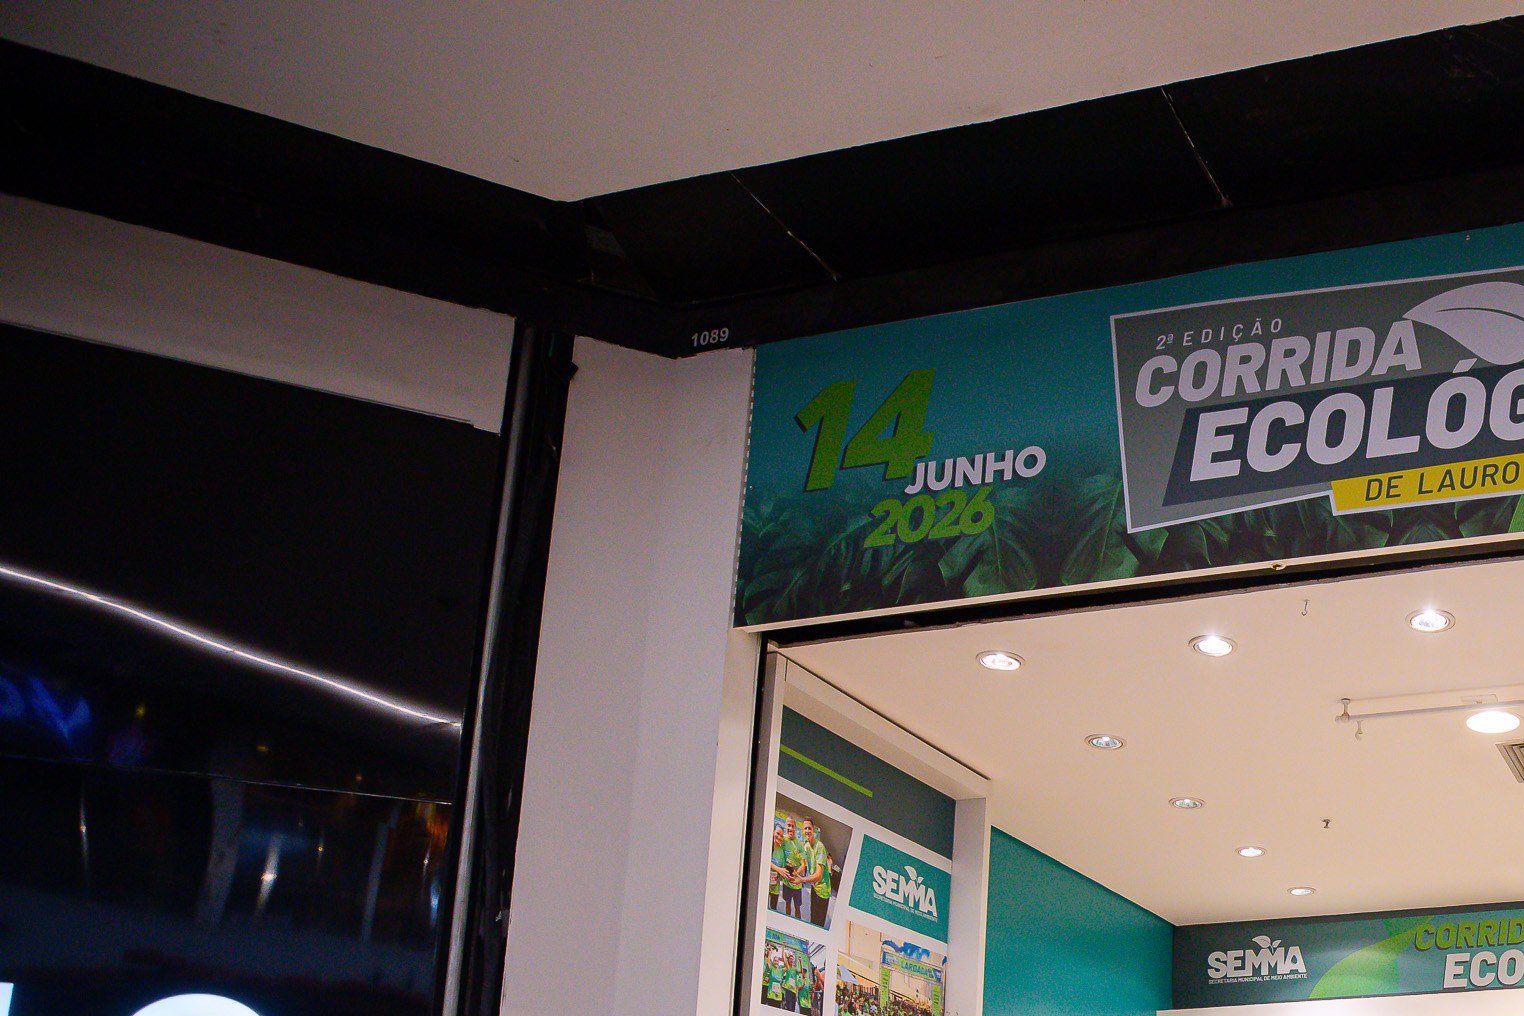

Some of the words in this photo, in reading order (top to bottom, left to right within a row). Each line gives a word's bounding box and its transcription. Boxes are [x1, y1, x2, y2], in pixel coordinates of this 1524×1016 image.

[691, 327, 729, 347] 1089
[1155, 333, 1174, 350] 2ª
[1182, 318, 1283, 346] EDIÇÃO
[1135, 319, 1422, 408] CORRIDA
[795, 367, 937, 492] 14
[904, 445, 1047, 495] JUNHO
[1364, 475, 1404, 502] DE
[1417, 460, 1521, 495] LAURO
[863, 486, 996, 549] 2026
[873, 865, 938, 918] SEMMA
[1207, 946, 1307, 979] SEMMA
